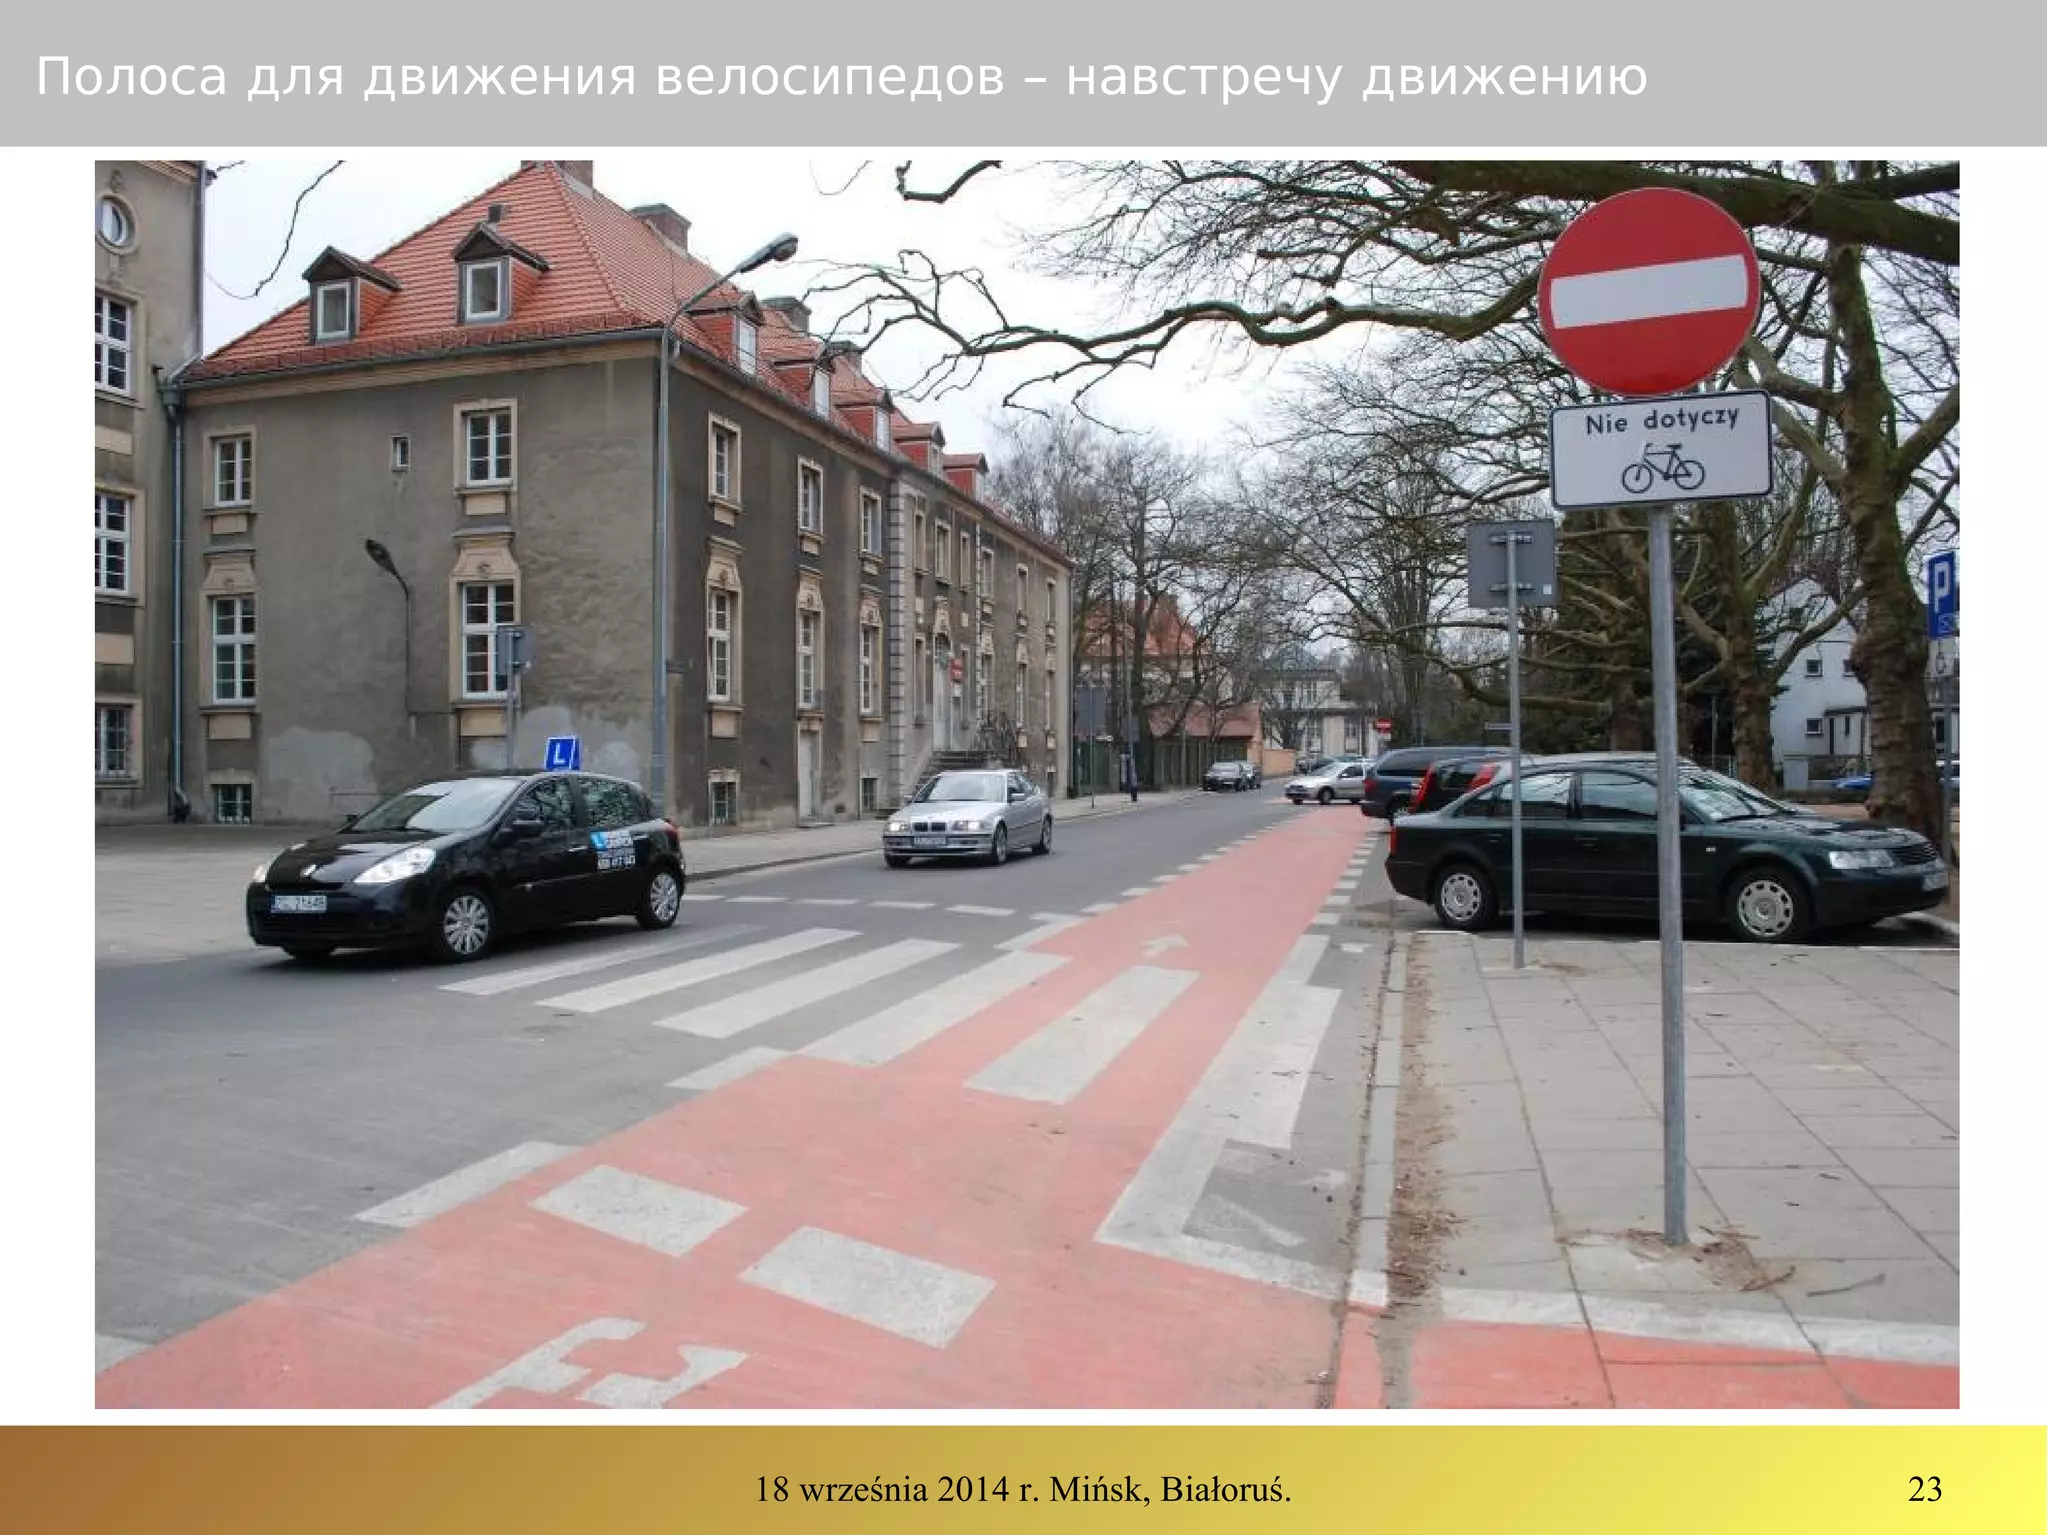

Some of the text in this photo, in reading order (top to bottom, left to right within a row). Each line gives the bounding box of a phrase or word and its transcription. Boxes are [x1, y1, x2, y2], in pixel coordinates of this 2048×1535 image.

[1585, 406, 1740, 435] Nie dotyczy
[1934, 560, 1950, 613] P
[553, 742, 566, 765] L
